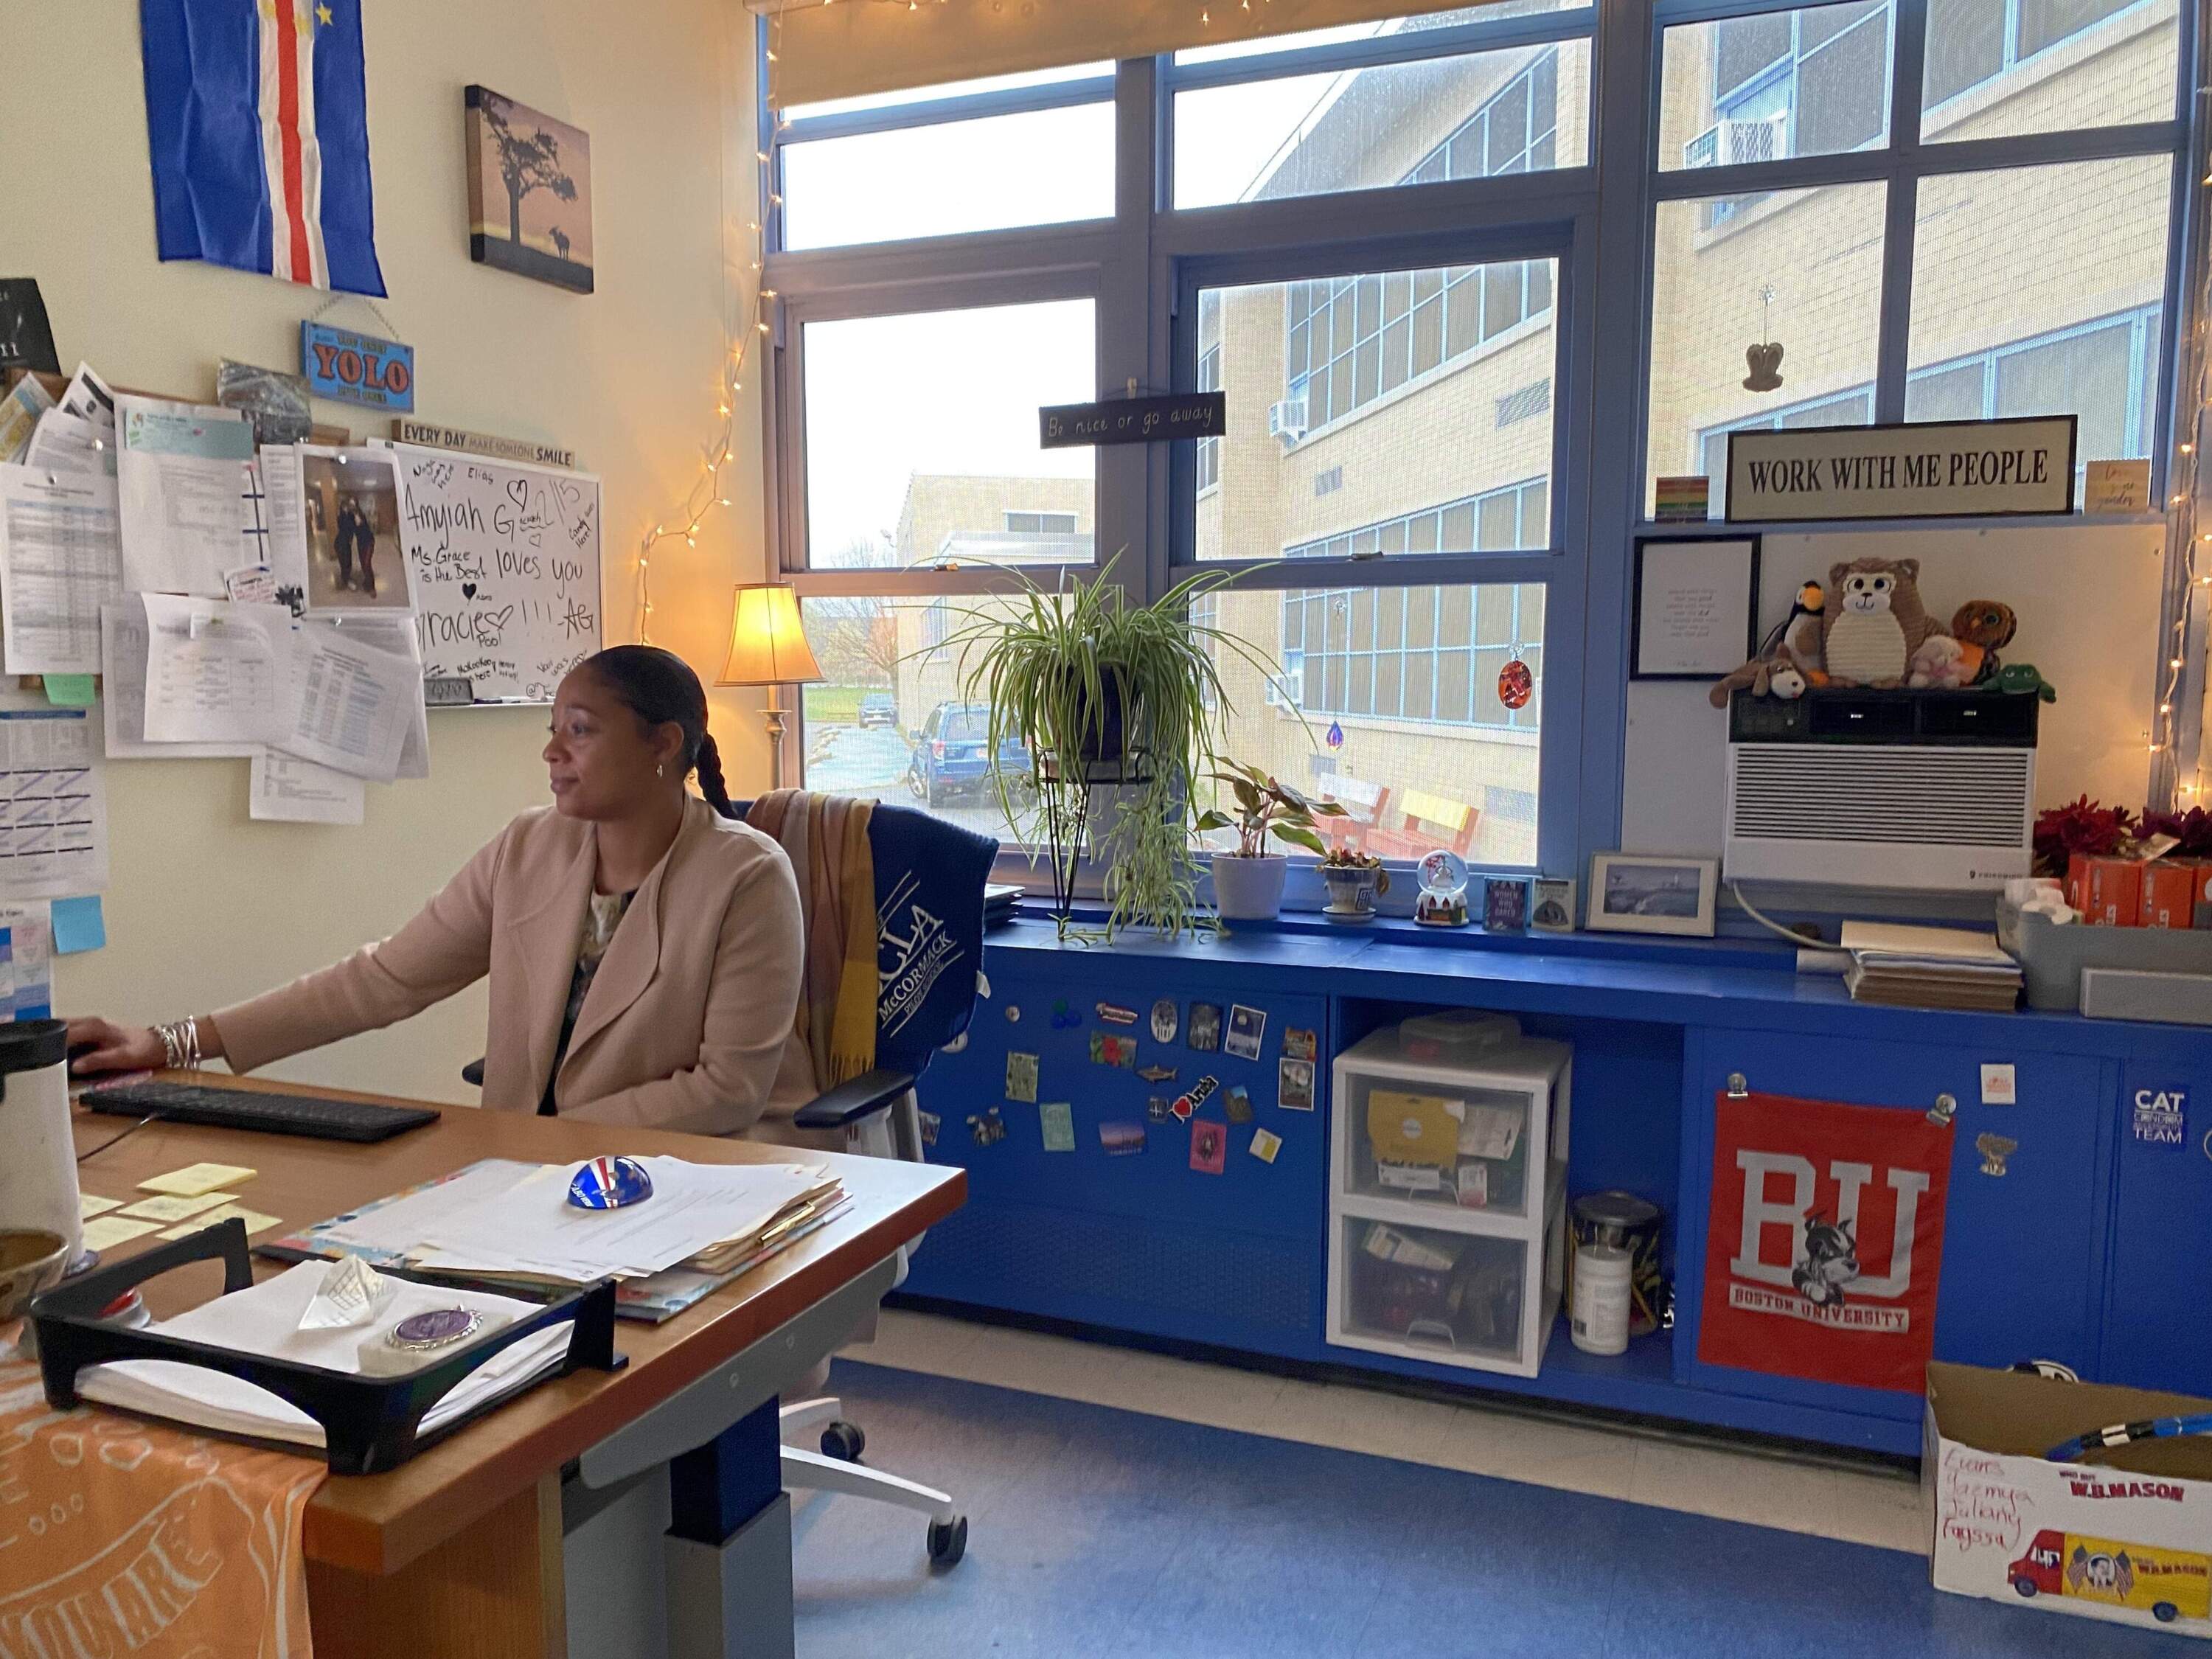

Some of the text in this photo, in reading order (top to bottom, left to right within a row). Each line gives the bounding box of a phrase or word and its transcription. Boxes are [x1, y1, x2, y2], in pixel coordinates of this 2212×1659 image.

[312, 344, 409, 395] YOLO
[1048, 406, 1213, 437] Be nice or go away
[405, 424, 440, 443] EVERY
[445, 431, 466, 448] DAY
[495, 441, 535, 459] SOMEONE
[536, 446, 571, 467] SMILE
[1748, 448, 2048, 494] WORK WITH ME PEOPLE
[494, 504, 515, 543] G
[495, 548, 583, 599] loves you
[878, 930, 952, 1021] McCORMACK
[2135, 1090, 2185, 1113] CAT
[2134, 1127, 2183, 1144] TEAM
[1730, 1149, 1930, 1299] BU
[1734, 1288, 1905, 1328] BOSTON UNIVERSITY
